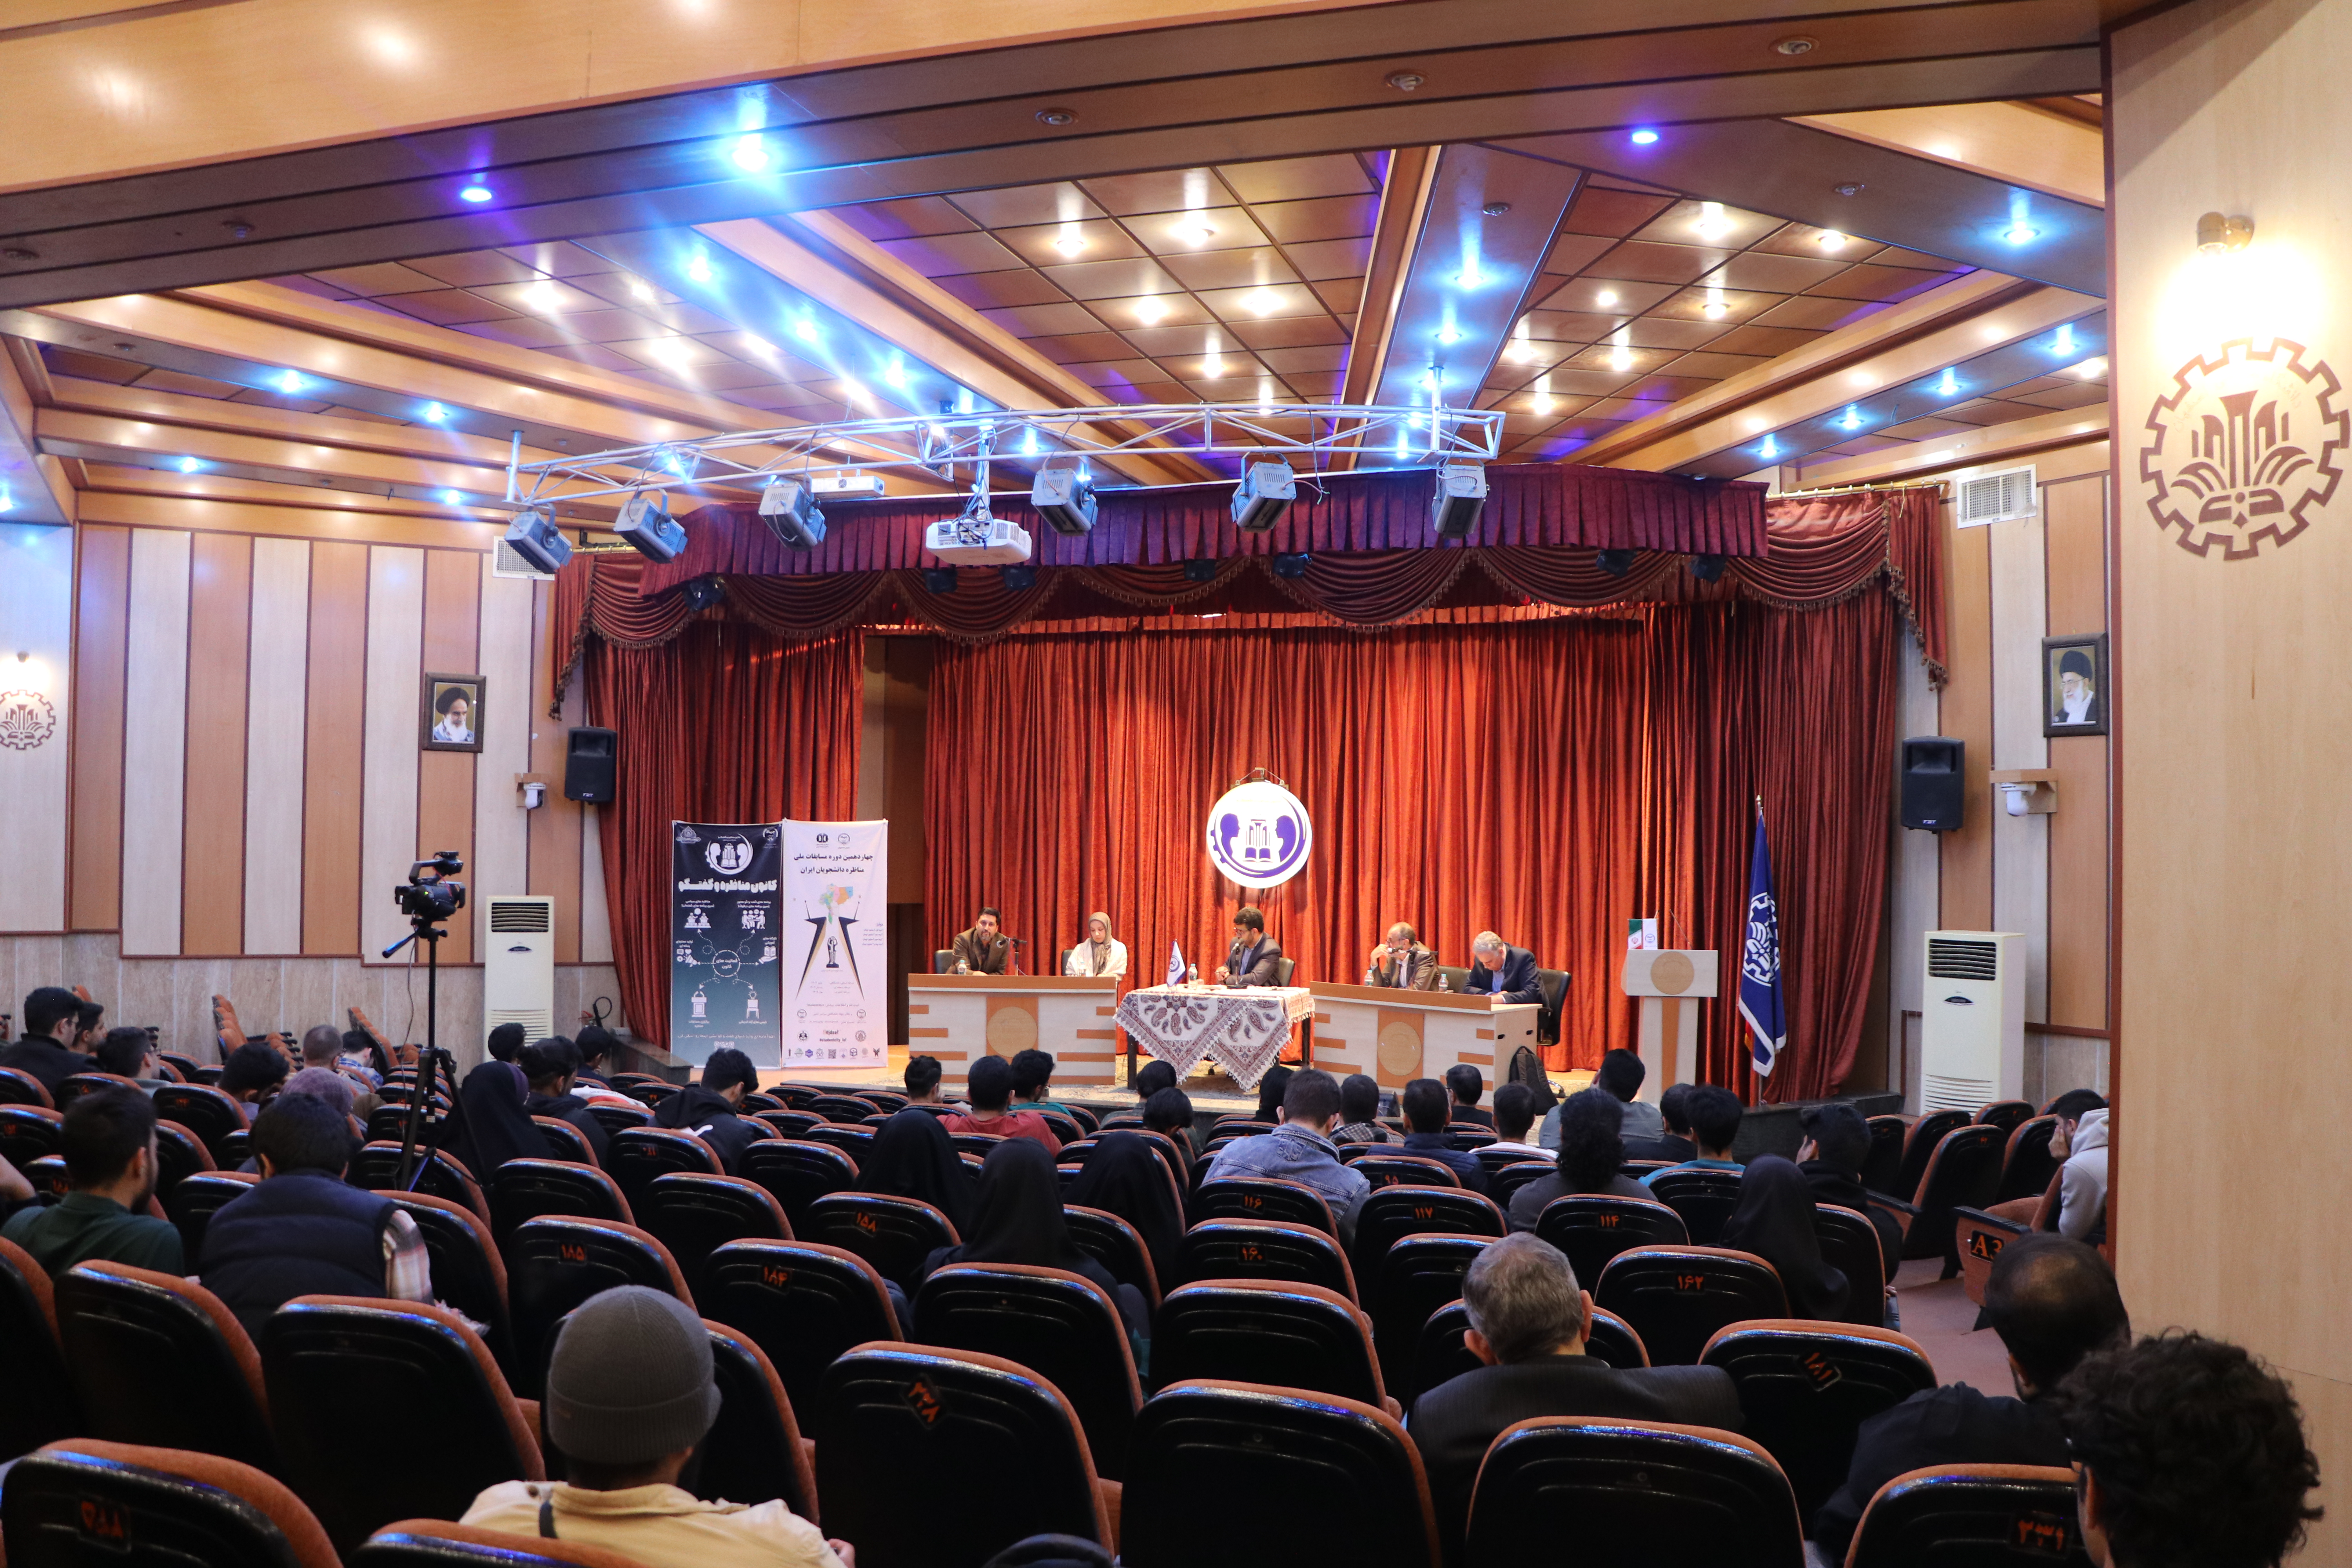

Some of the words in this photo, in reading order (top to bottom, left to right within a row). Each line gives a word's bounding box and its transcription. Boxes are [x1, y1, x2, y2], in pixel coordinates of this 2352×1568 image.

[714, 882, 720, 893] و
[720, 879, 750, 893] مناظره
[750, 879, 777, 893] کانون
[1245, 1196, 1262, 1208] ۱۱۶
[1416, 1208, 1433, 1217] ۱۱۷
[857, 1213, 876, 1232] ۱۵۸
[1601, 1216, 1619, 1226] ۱۱۴
[562, 1245, 584, 1260] ۱۸۵
[1243, 1247, 1262, 1259] ۱۶۰
[1678, 1276, 1704, 1289] ۱۶۲
